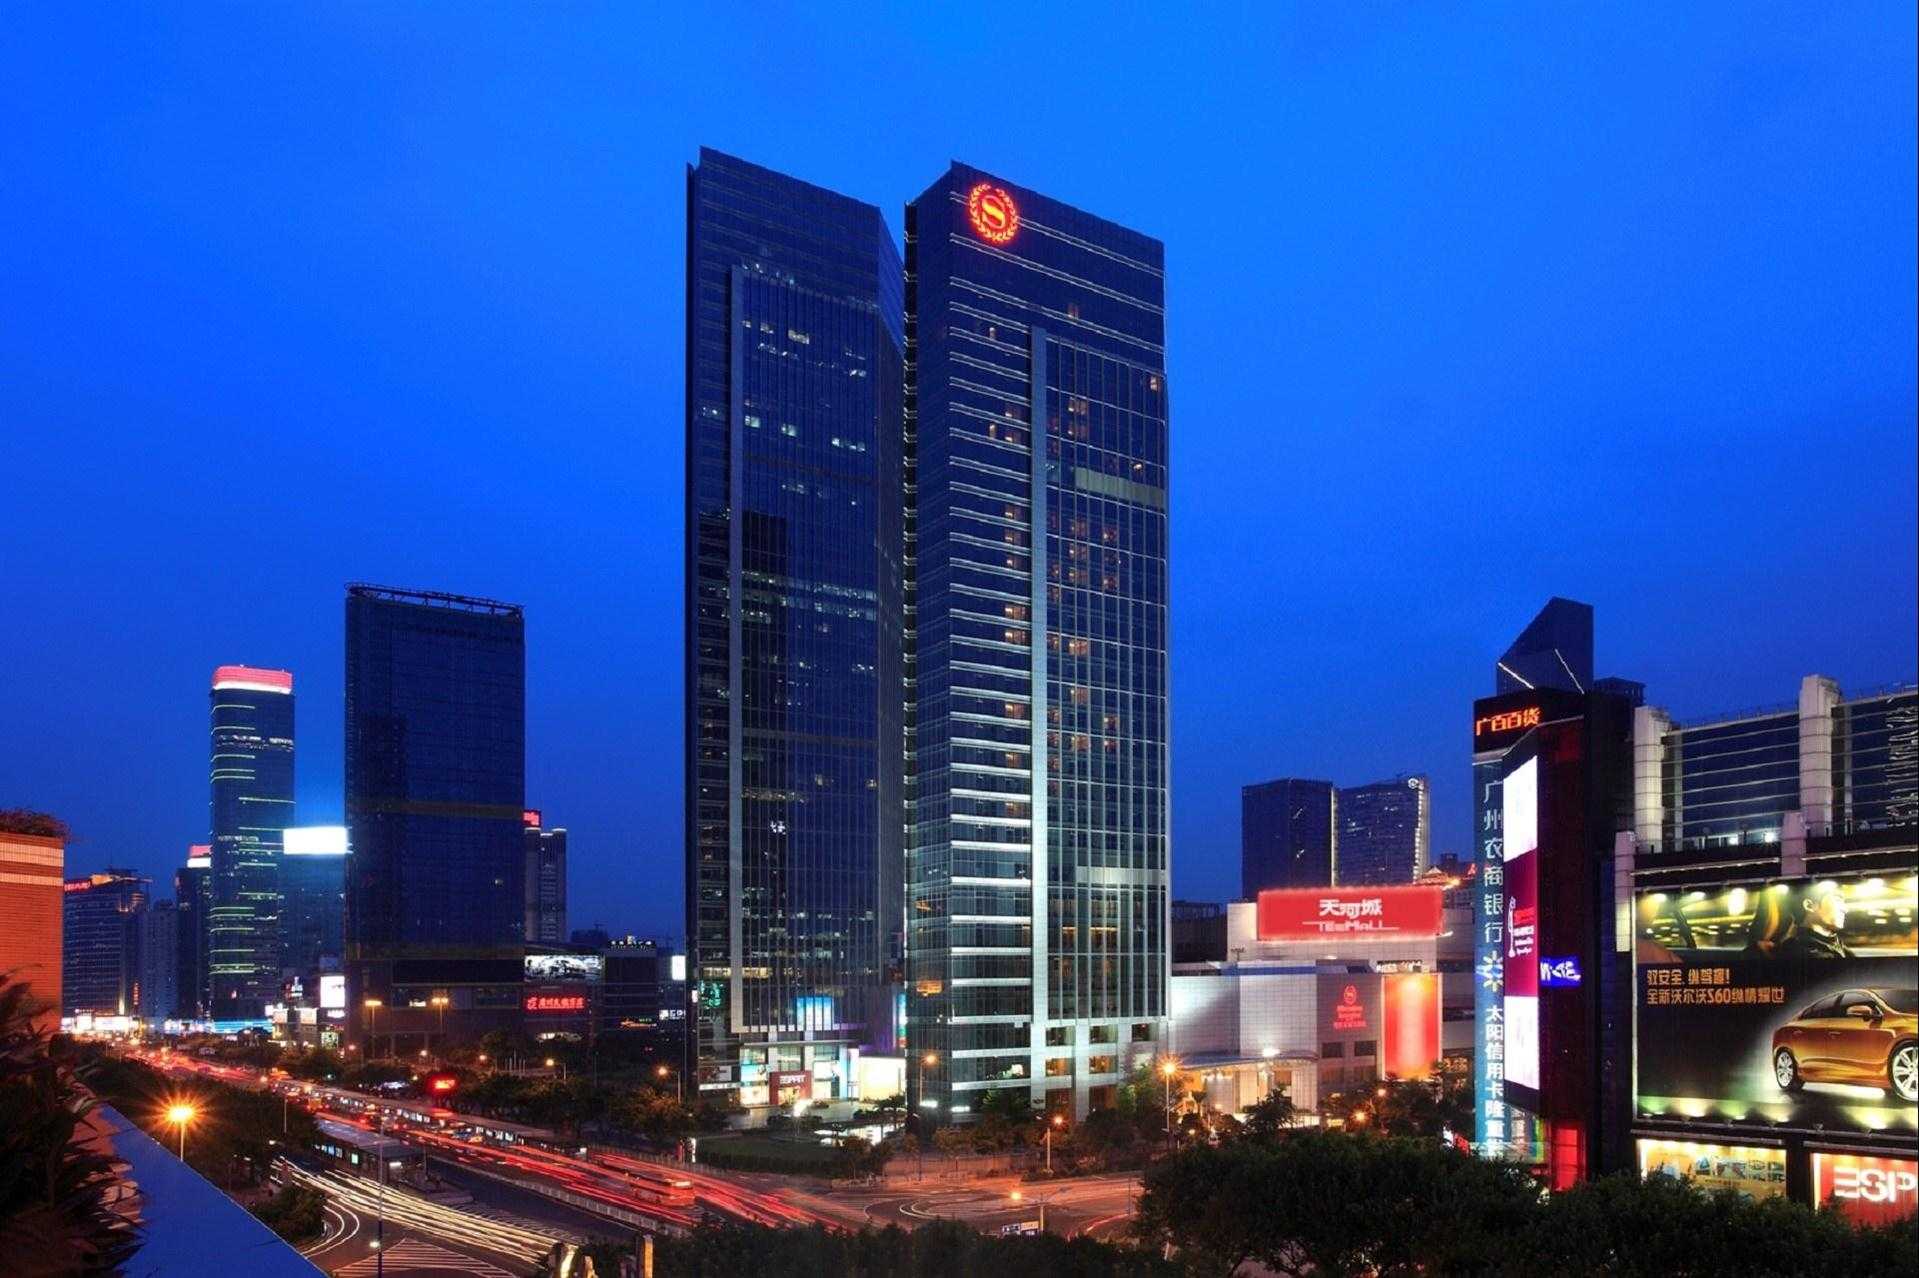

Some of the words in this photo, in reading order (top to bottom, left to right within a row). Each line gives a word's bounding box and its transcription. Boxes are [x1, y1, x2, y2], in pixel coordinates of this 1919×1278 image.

[1476, 707, 1540, 736] 广百百货
[1319, 898, 1383, 919] 天河城
